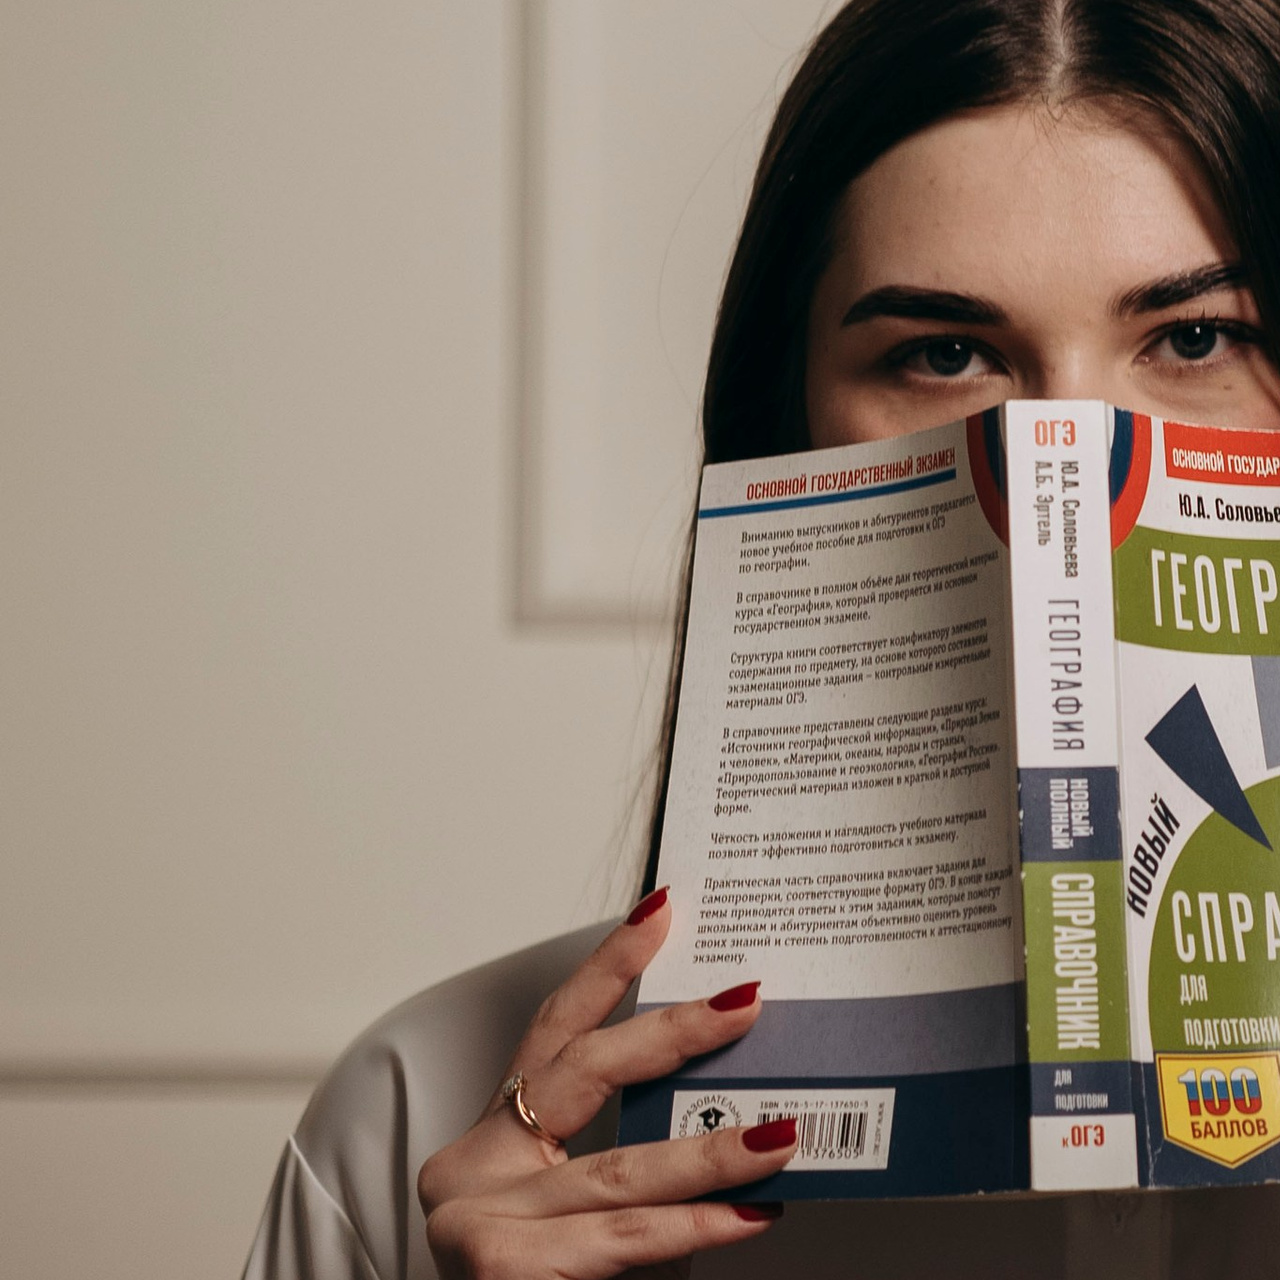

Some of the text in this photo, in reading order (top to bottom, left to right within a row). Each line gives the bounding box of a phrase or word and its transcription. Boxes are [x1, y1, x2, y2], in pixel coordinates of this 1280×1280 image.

[1034, 419, 1076, 448] ОГЭ
[747, 447, 956, 500] ОСНОВНОЙ ГОСУДАРСТВЕННЫЙ ЭКЗАМЕН
[1172, 447, 1224, 473] ОСНОВНОЙ
[1034, 461, 1054, 546] А.Б. Эртель
[1061, 461, 1080, 578] Ю.А. Соловьева
[1178, 493, 1210, 520] Ю.А.
[740, 516, 946, 558] новое учебное пособие для подготовки к ОГЭ
[741, 530, 794, 543] Вниманию
[797, 521, 861, 538] выпускников
[862, 519, 869, 528] и
[870, 507, 930, 527] абитуриентов
[738, 556, 811, 573] по географии.
[736, 592, 743, 604] В
[746, 587, 811, 604] справочнике
[813, 587, 819, 596] в
[821, 581, 858, 594] полном
[860, 575, 893, 589] объёме
[895, 573, 911, 585] дан
[913, 558, 968, 581] теоретический
[735, 607, 764, 621] курса
[766, 599, 833, 616] «География»,
[835, 591, 876, 607] который
[878, 584, 932, 604] проверяется
[933, 580, 943, 591] на
[733, 611, 871, 635] государственном экзамене.
[728, 665, 792, 680] содержания
[794, 664, 807, 674] по
[809, 658, 859, 675] предмету,
[861, 656, 873, 666] на
[874, 651, 906, 663] основе
[908, 643, 946, 658] которого
[730, 650, 784, 666] Структура
[786, 648, 817, 659] книги
[819, 639, 887, 656] соответствует
[889, 626, 950, 646] кодификатору
[727, 677, 821, 694] экзаменационные
[823, 672, 864, 686] задания
[874, 663, 934, 679] контрольные
[1048, 599, 1084, 751] ГЕОГРАФИЯ
[726, 692, 808, 710] материалы ОГЭ.
[722, 698, 987, 740] В справочнике представлены следующие разделы курса:
[719, 760, 726, 769] и
[729, 758, 781, 768] человек»,
[783, 752, 842, 765] «Материки,
[845, 748, 883, 760] океаны,
[886, 742, 920, 756] народы
[923, 740, 928, 749] и
[720, 740, 785, 754] «Источники
[788, 729, 871, 749] географической
[874, 725, 939, 742] информации»,
[717, 766, 837, 786] «Природопользование
[840, 766, 846, 775] и
[849, 760, 917, 774] геоэкология»,
[918, 748, 967, 766] «География
[715, 783, 797, 802] Теоретический
[799, 781, 849, 795] материал
[851, 777, 894, 790] изложен
[897, 776, 902, 785] в
[904, 766, 941, 785] краткой
[942, 769, 949, 778] и
[713, 802, 752, 817] форме.
[1050, 778, 1073, 850] ПОЛНЫЙ
[1070, 778, 1094, 838] НОВЫЙ
[708, 831, 959, 860] позволят эффективно подготовиться к экзамену.
[710, 832, 760, 845] Чёткость
[762, 830, 822, 842] изложения
[825, 829, 831, 838] и
[834, 824, 897, 838] наглядность
[899, 817, 942, 835] учебного
[1126, 792, 1181, 918] НОВЫЙ
[701, 893, 783, 906] самопроверки,
[786, 886, 881, 901] соответствующие
[883, 881, 926, 897] формату
[928, 877, 947, 890] ОГЭ.
[950, 875, 956, 887] В
[958, 874, 983, 885] конце
[704, 877, 781, 892] Практическая
[784, 875, 814, 886] часть
[816, 871, 884, 886] справочника
[887, 866, 933, 879] включает
[936, 861, 970, 874] задания
[697, 903, 997, 934] школьникам и абитуриентам объективно оценить уровень
[699, 909, 727, 919] темы
[730, 907, 794, 920] приводятся
[797, 905, 836, 915] ответы
[840, 904, 845, 913] к
[848, 903, 873, 913] этим
[876, 898, 925, 912] заданиям,
[927, 892, 965, 905] которые
[694, 917, 1013, 949] своих знаний и степень подготовленности к аттестационному
[692, 953, 748, 965] экзамену.
[1051, 873, 1100, 1050] СПРАВОЧНИК
[760, 1101, 779, 1110] ISBN
[1177, 1066, 1263, 1117] 100
[679, 1094, 743, 1138] ОБРАЗОВАТЕЛЬНЫ
[1191, 1118, 1268, 1140] БАЛЛОВ
[1071, 1124, 1105, 1148] ОГЭ
[813, 1148, 860, 1160] 376505
